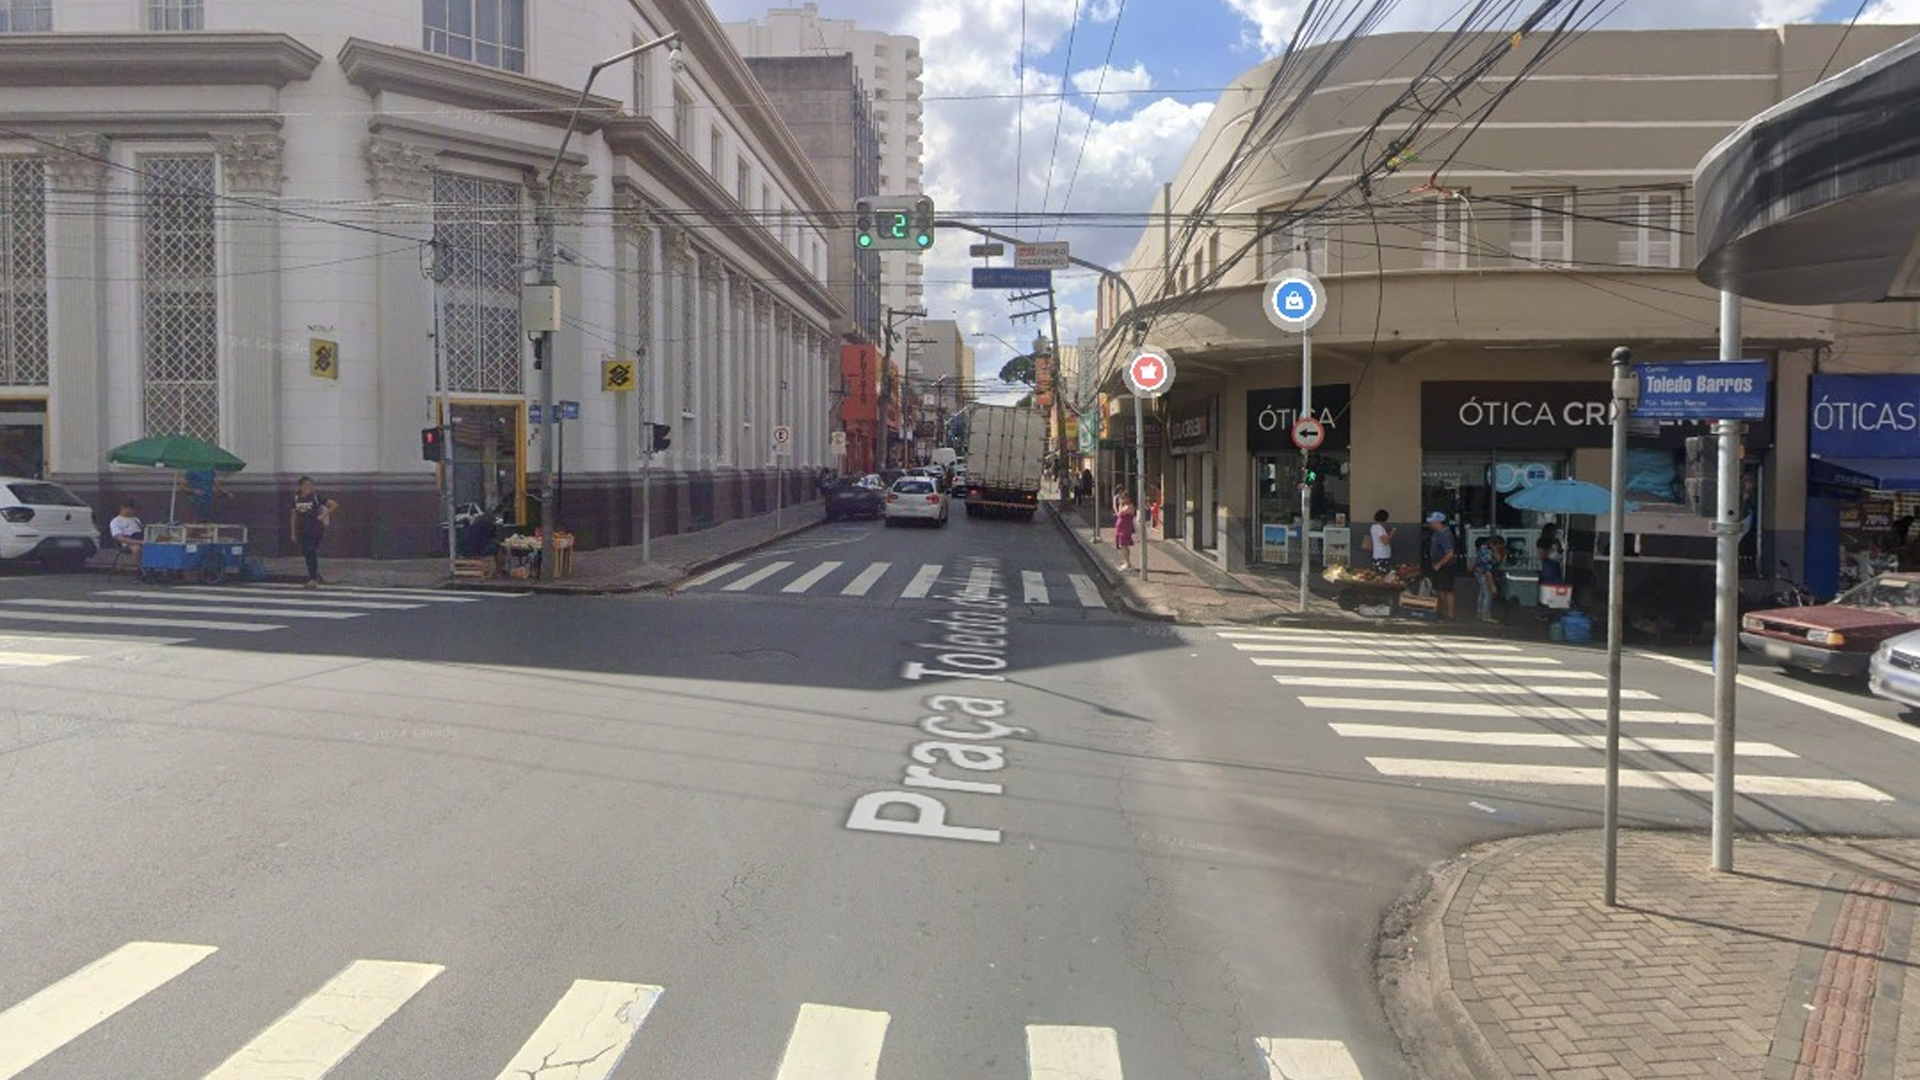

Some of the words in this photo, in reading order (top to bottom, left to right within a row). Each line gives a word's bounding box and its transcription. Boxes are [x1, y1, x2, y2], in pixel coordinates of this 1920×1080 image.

[892, 214, 906, 237] 2
[1646, 375, 1692, 393] Toledo
[1696, 375, 1753, 393] Barros
[1258, 404, 1337, 432] ÓTIA
[1458, 396, 1556, 426] ÓTICA
[1813, 394, 1917, 431] ÓTICAS
